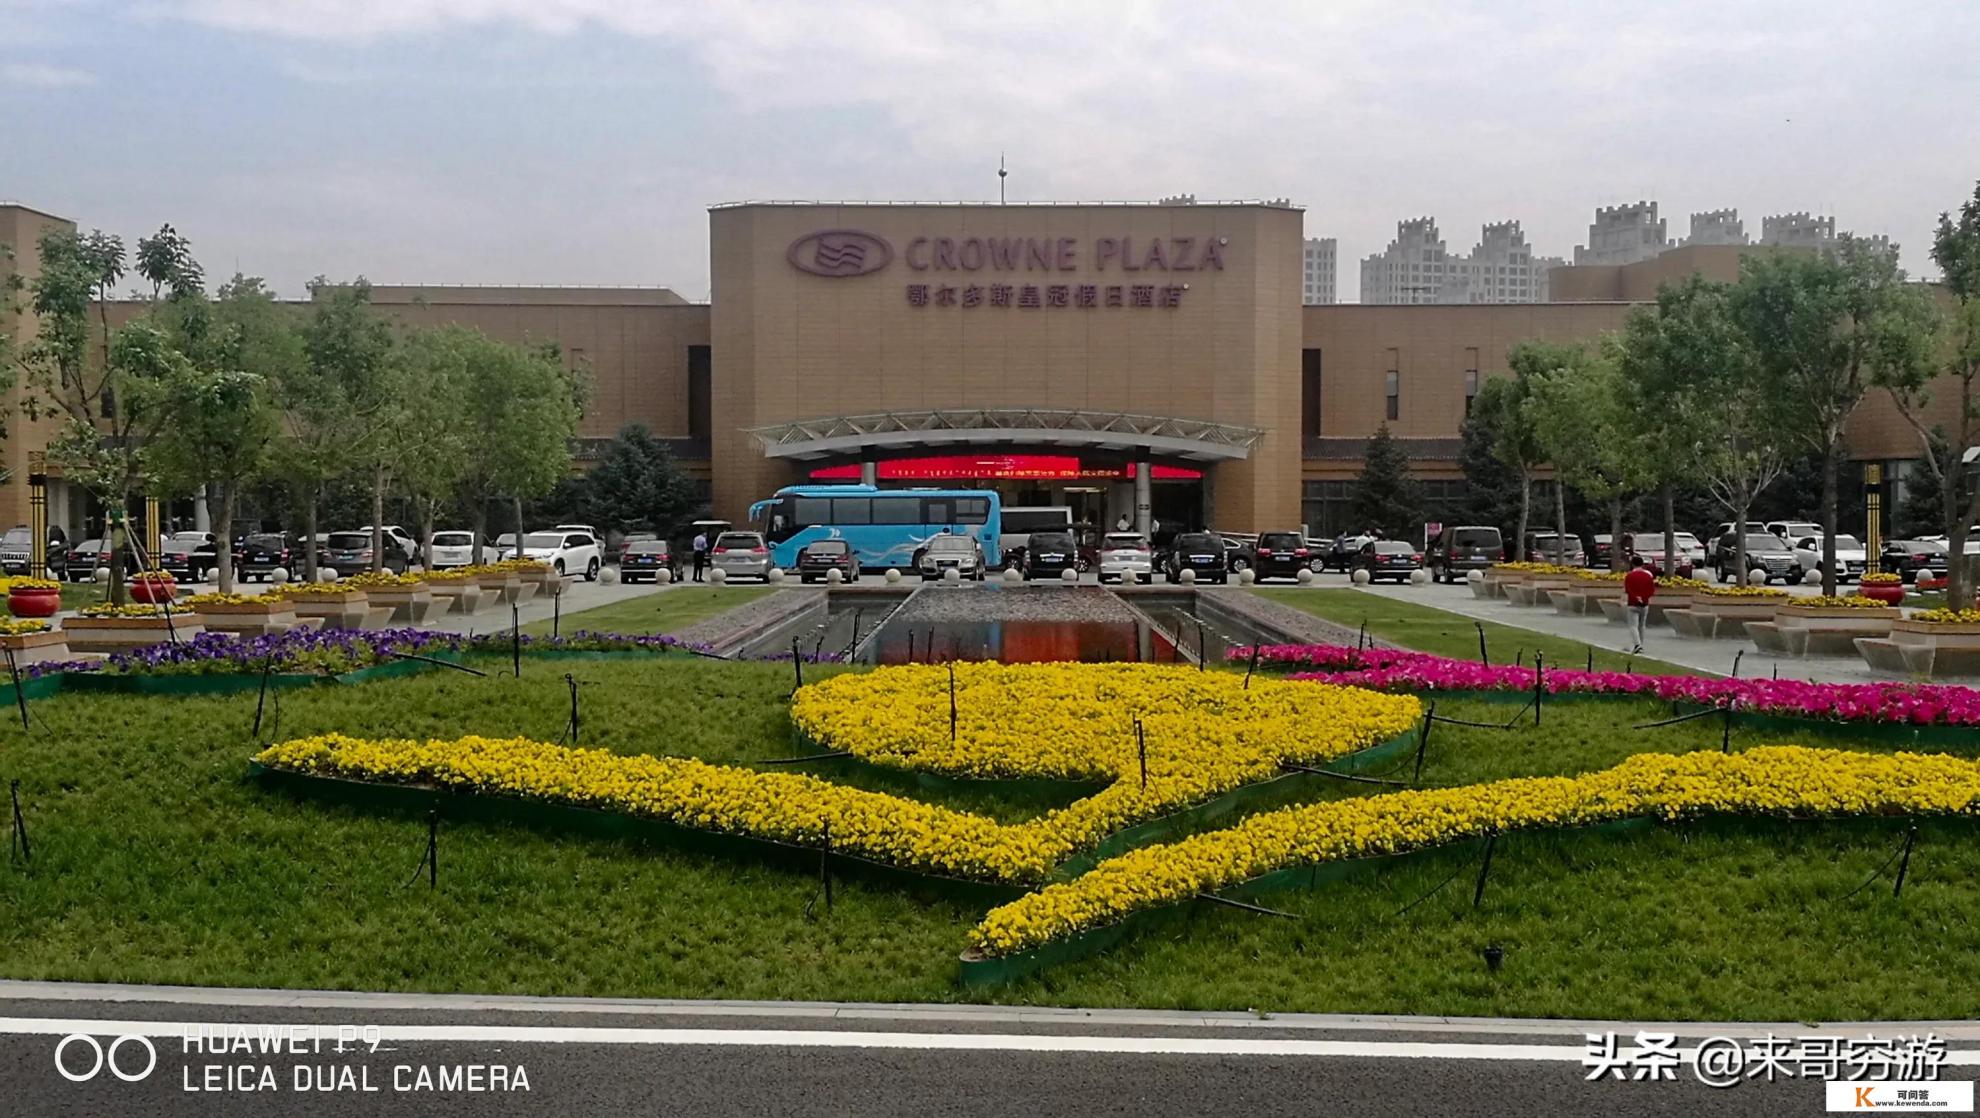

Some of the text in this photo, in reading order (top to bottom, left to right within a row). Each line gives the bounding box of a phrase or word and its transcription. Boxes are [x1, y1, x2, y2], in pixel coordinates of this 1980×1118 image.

[906, 237, 1224, 271] CROWNE PLAZA
[907, 284, 1184, 309] 鄂尔多斯皇冠假日酒店
